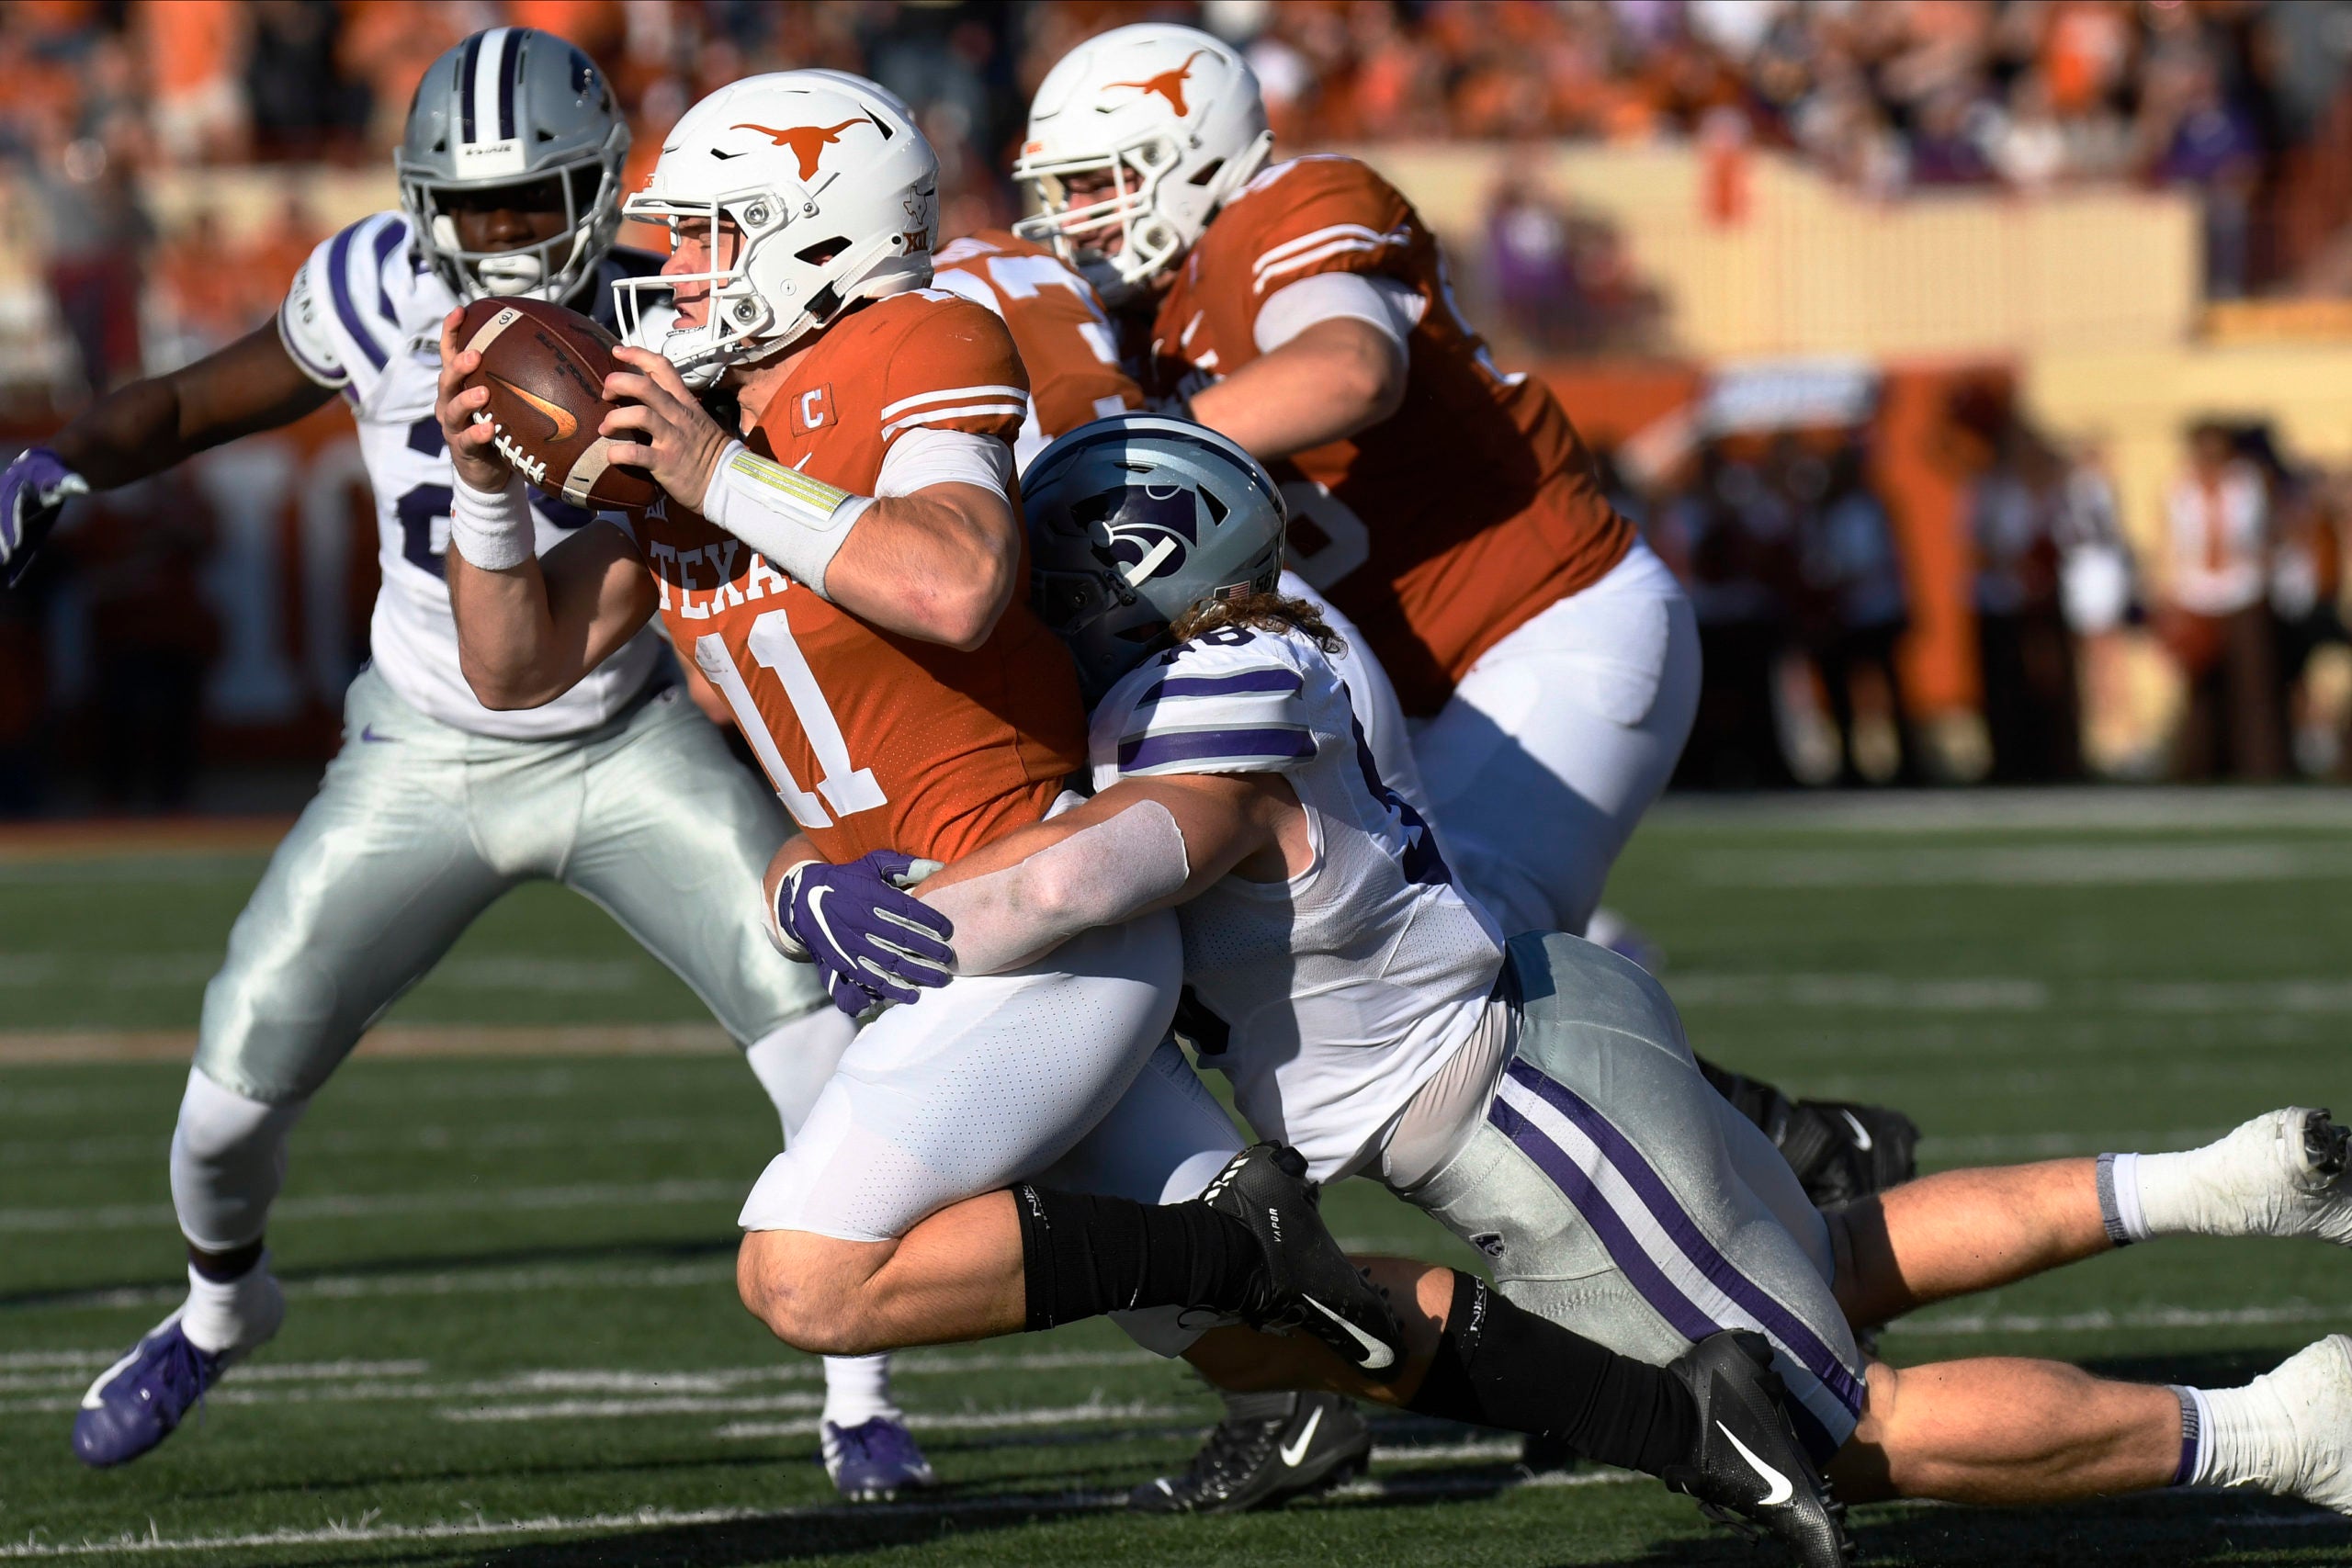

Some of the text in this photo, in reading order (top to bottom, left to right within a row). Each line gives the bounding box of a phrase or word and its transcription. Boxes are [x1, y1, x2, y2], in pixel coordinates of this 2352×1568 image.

[801, 389, 824, 429] C
[650, 539, 801, 620] TEXA
[695, 609, 888, 829] 11
[1269, 1208, 1282, 1242] VAPOR
